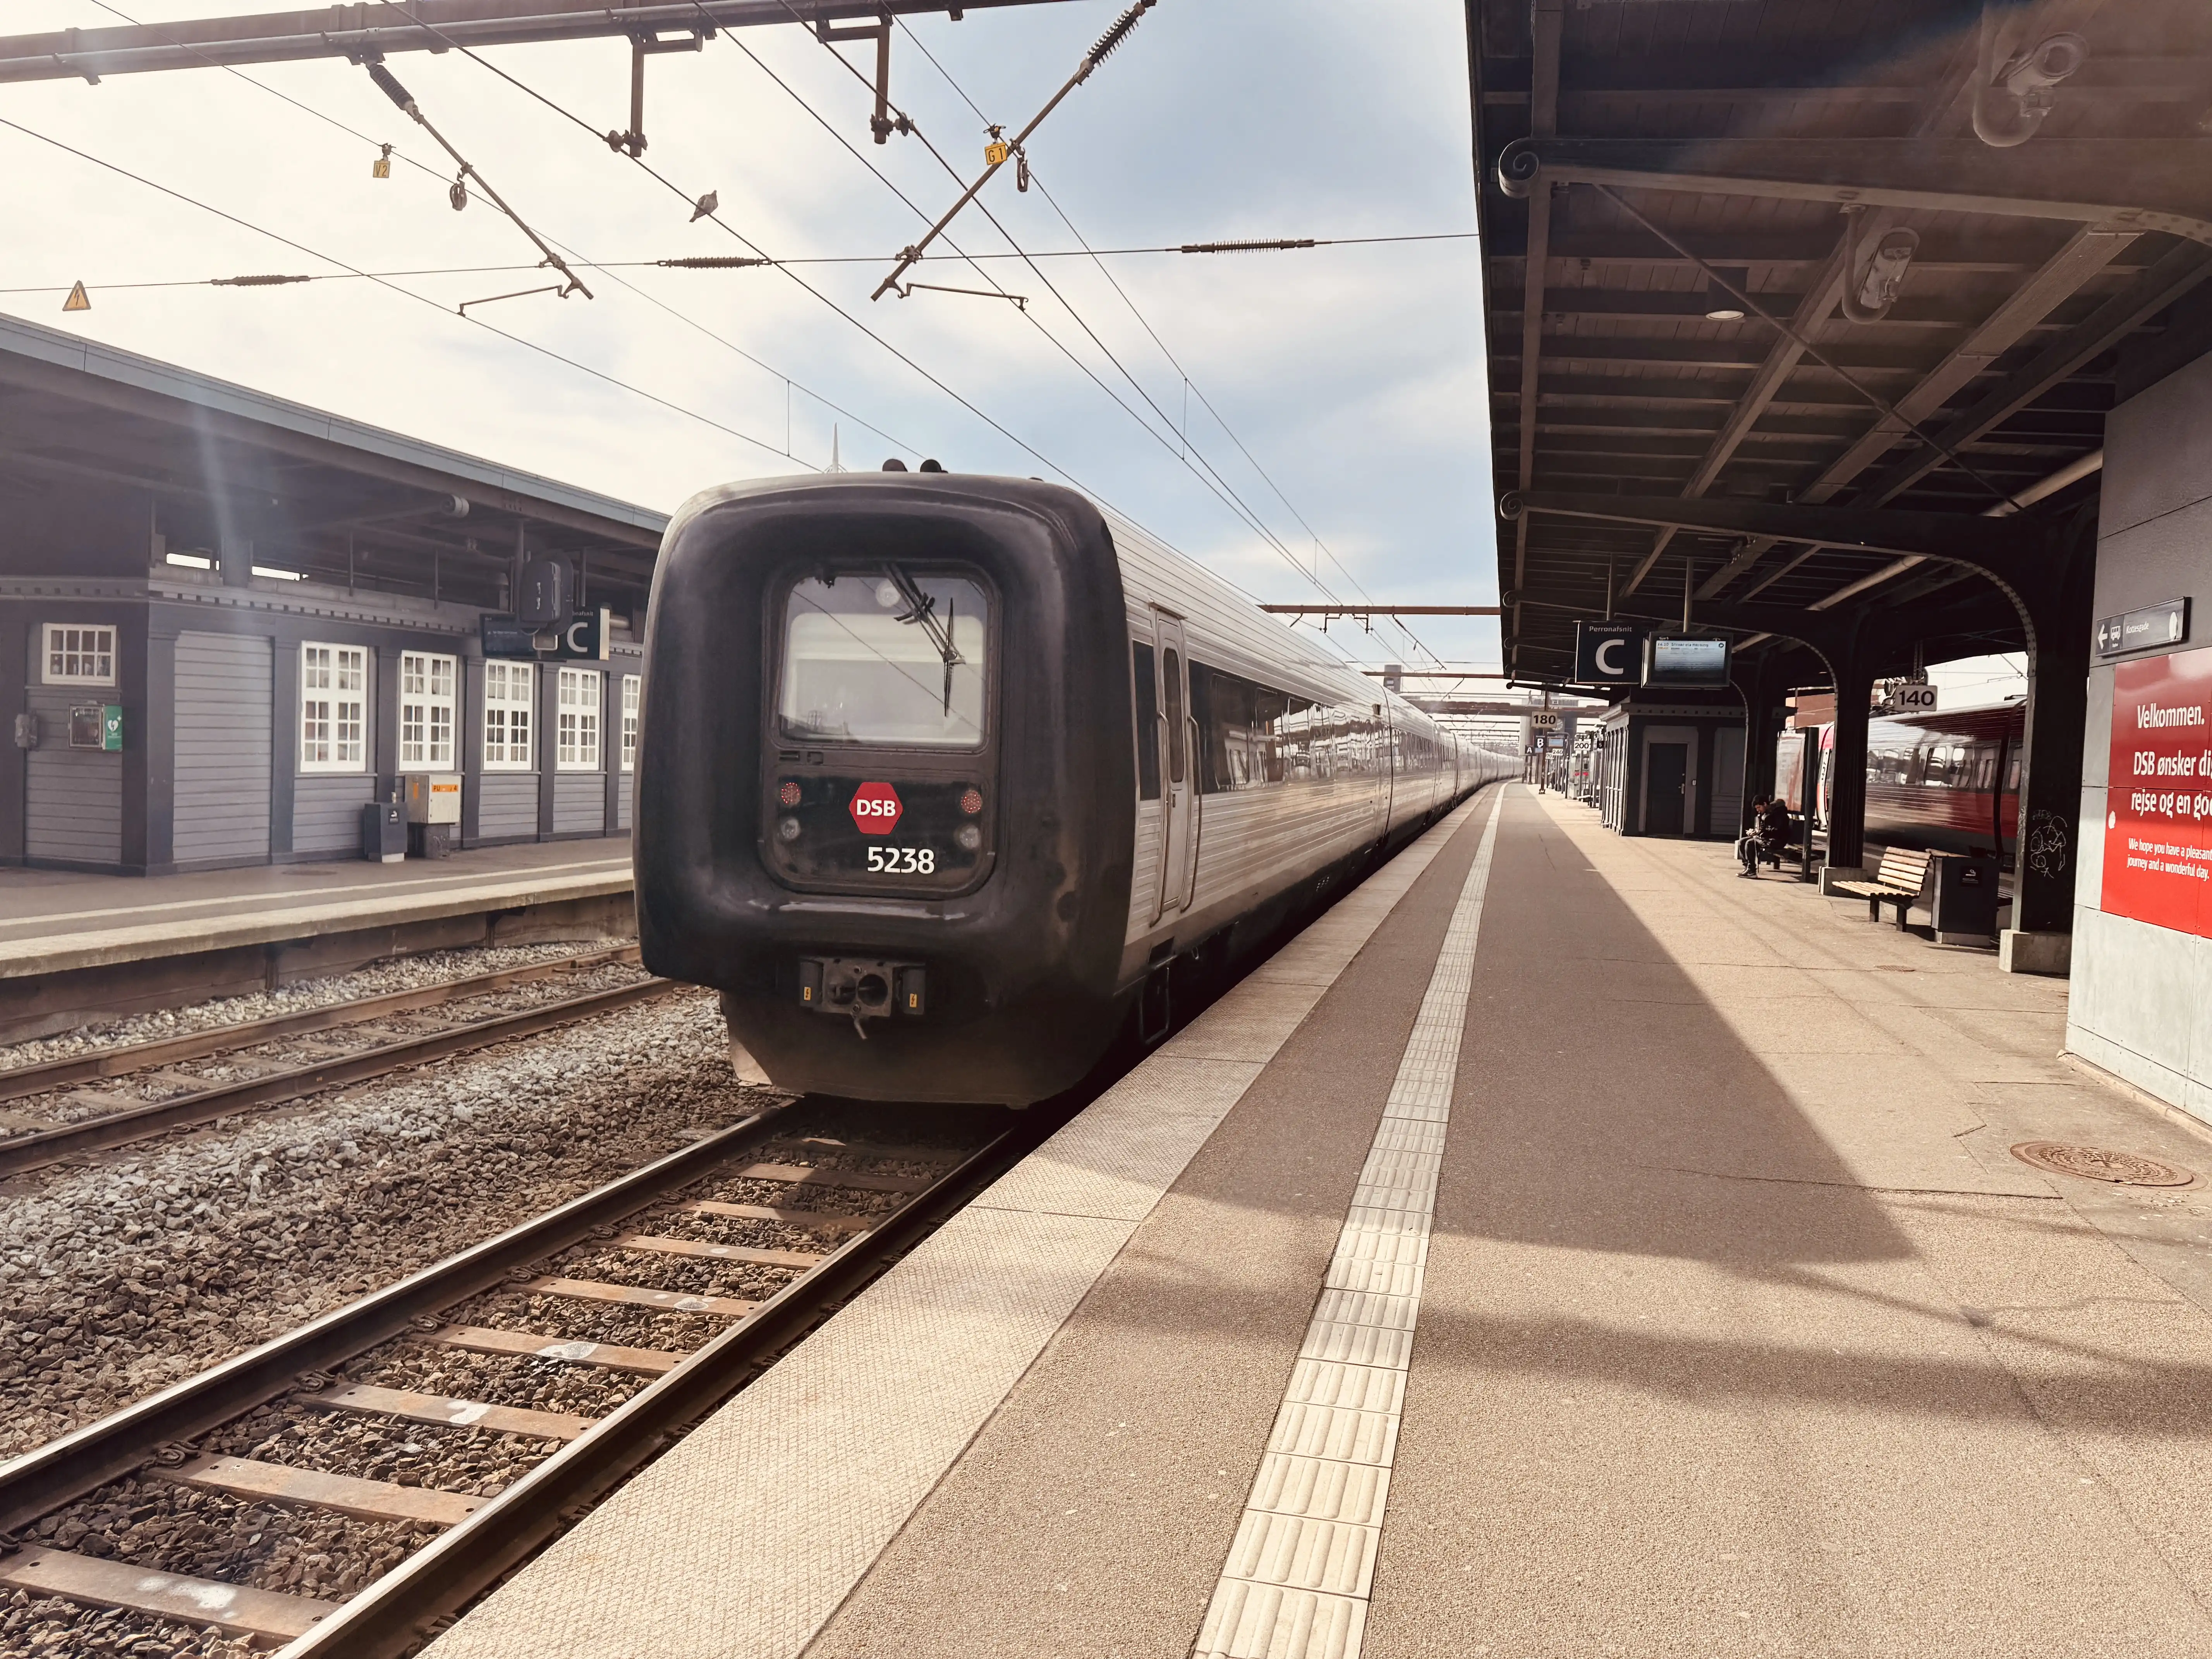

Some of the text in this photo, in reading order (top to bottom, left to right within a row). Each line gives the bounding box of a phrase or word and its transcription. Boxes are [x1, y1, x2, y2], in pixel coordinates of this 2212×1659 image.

[567, 622, 588, 652] C
[1595, 639, 1625, 675] C
[1899, 690, 1935, 706] 140
[1534, 715, 1556, 725] 180
[2137, 703, 2205, 728] Velkommen.
[1537, 738, 1544, 747] B
[2133, 751, 2155, 775] DSB
[2157, 750, 2197, 776] ønsker
[857, 799, 896, 816] DSB
[2131, 787, 2156, 817] rejse
[2159, 792, 2174, 818] og
[2177, 795, 2190, 814] en
[2128, 838, 2138, 850] We
[2139, 839, 2153, 855] hope
[2154, 843, 2165, 855] you
[2166, 842, 2180, 856] have
[2181, 847, 2185, 857] a
[867, 847, 934, 874] 5238
[2127, 854, 2210, 882] journey and a wonderful day.
